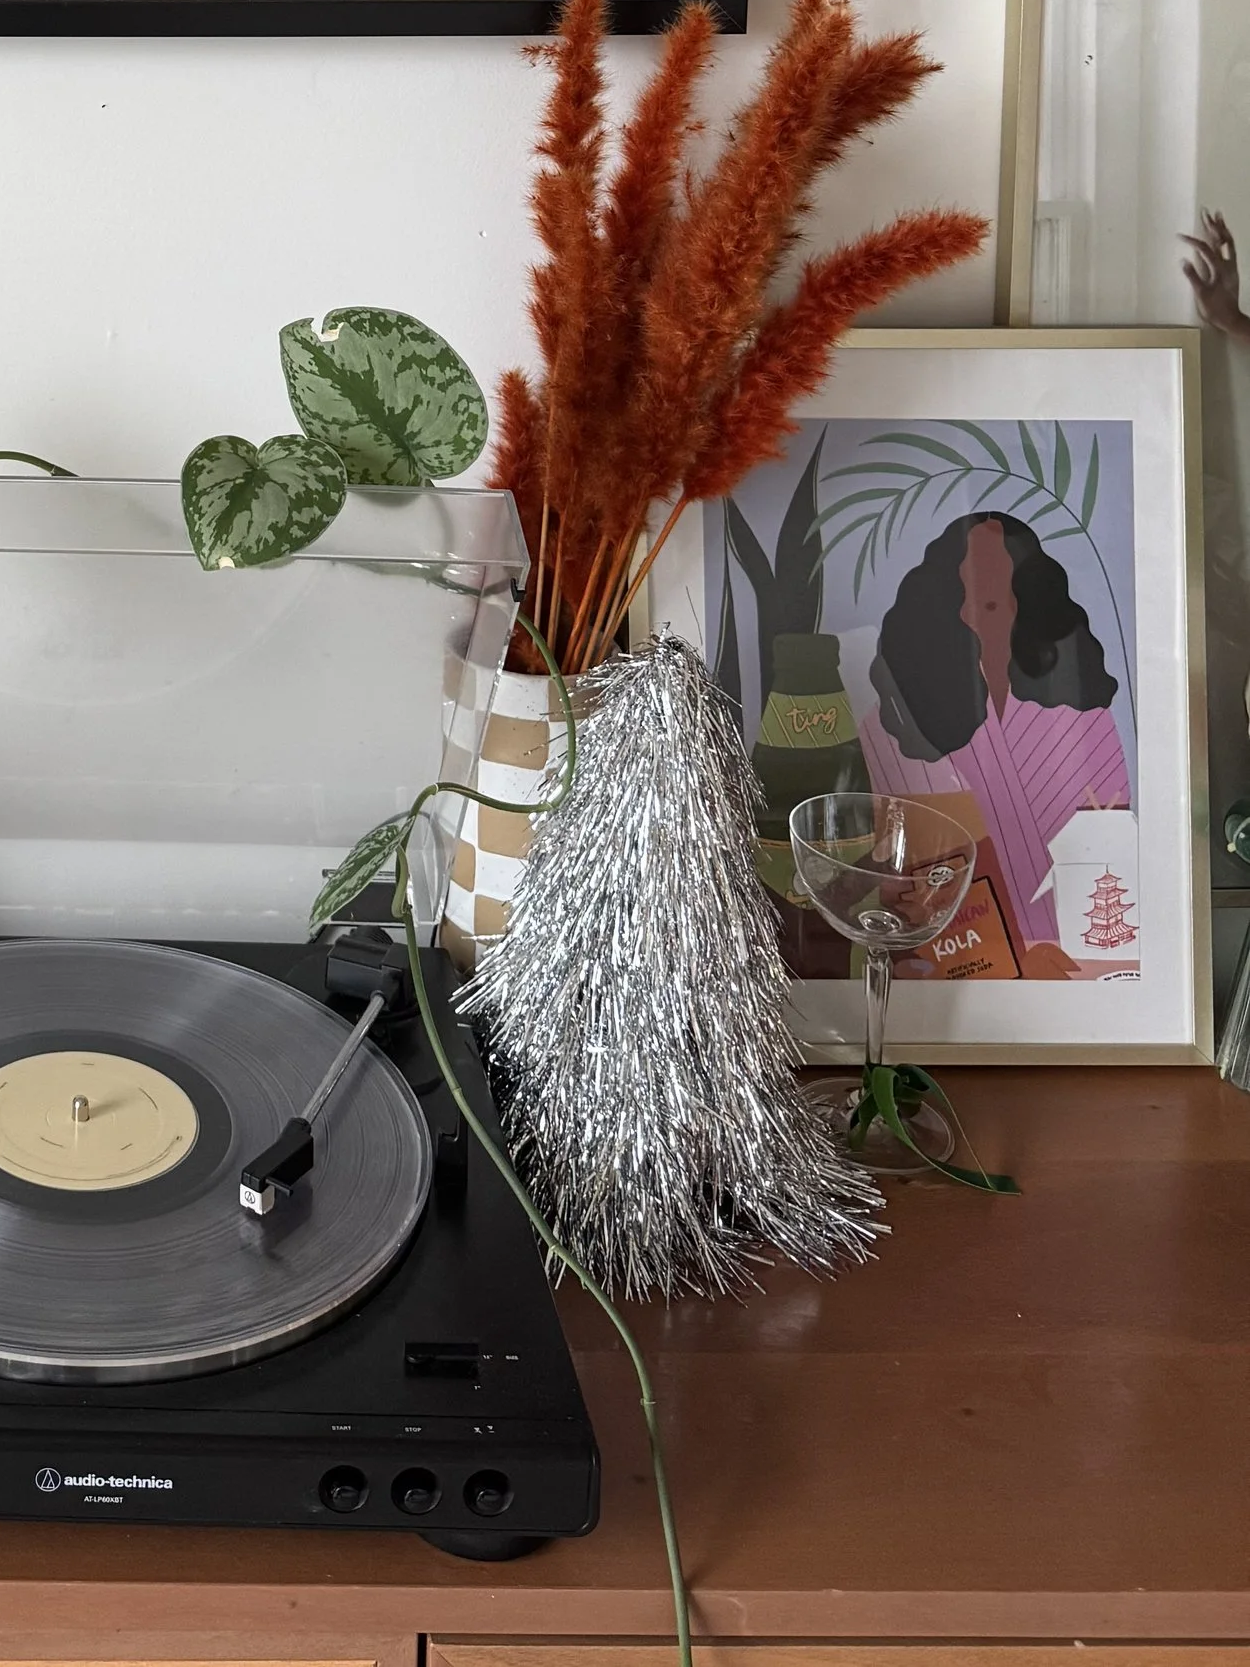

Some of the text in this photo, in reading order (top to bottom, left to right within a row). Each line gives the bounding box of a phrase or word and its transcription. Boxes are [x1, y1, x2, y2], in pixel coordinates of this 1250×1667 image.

[932, 929, 982, 962] KOLA
[64, 1473, 174, 1490] audio-technica
[83, 1495, 124, 1504] AT-LP60XBT
